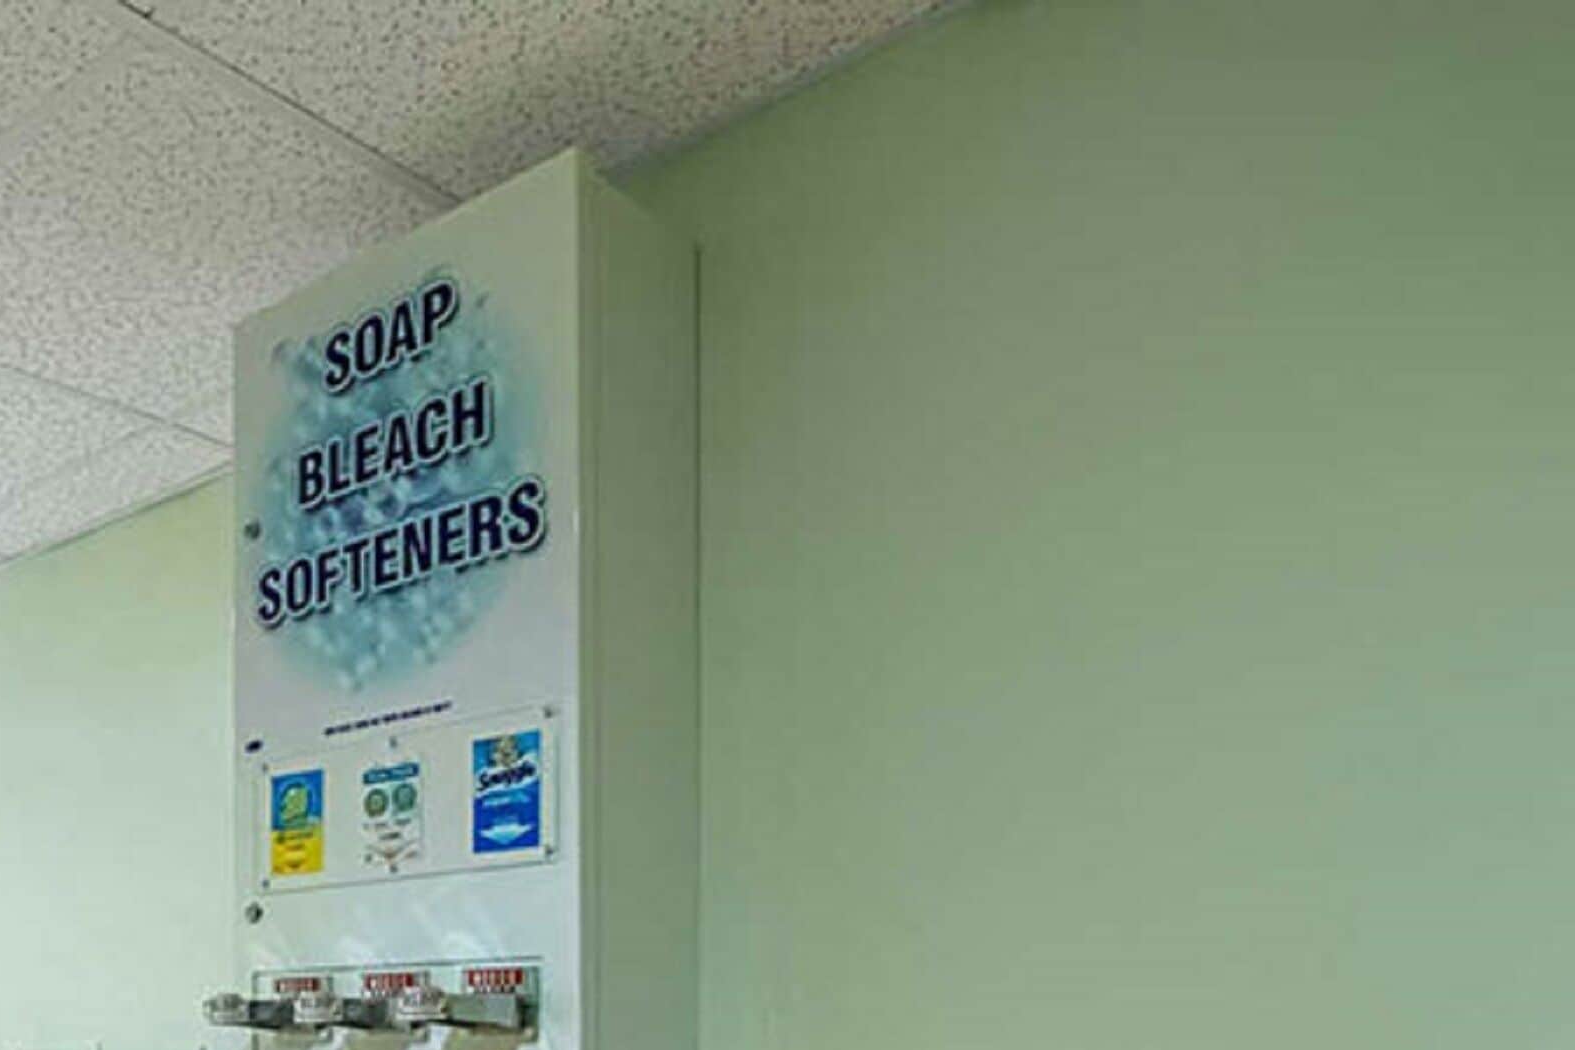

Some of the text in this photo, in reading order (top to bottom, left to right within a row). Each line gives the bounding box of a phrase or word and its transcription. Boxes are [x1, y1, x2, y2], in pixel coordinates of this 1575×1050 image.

[323, 280, 456, 390] SOAP
[296, 378, 489, 507] BLEACH
[256, 479, 542, 624] SOFTENERS
